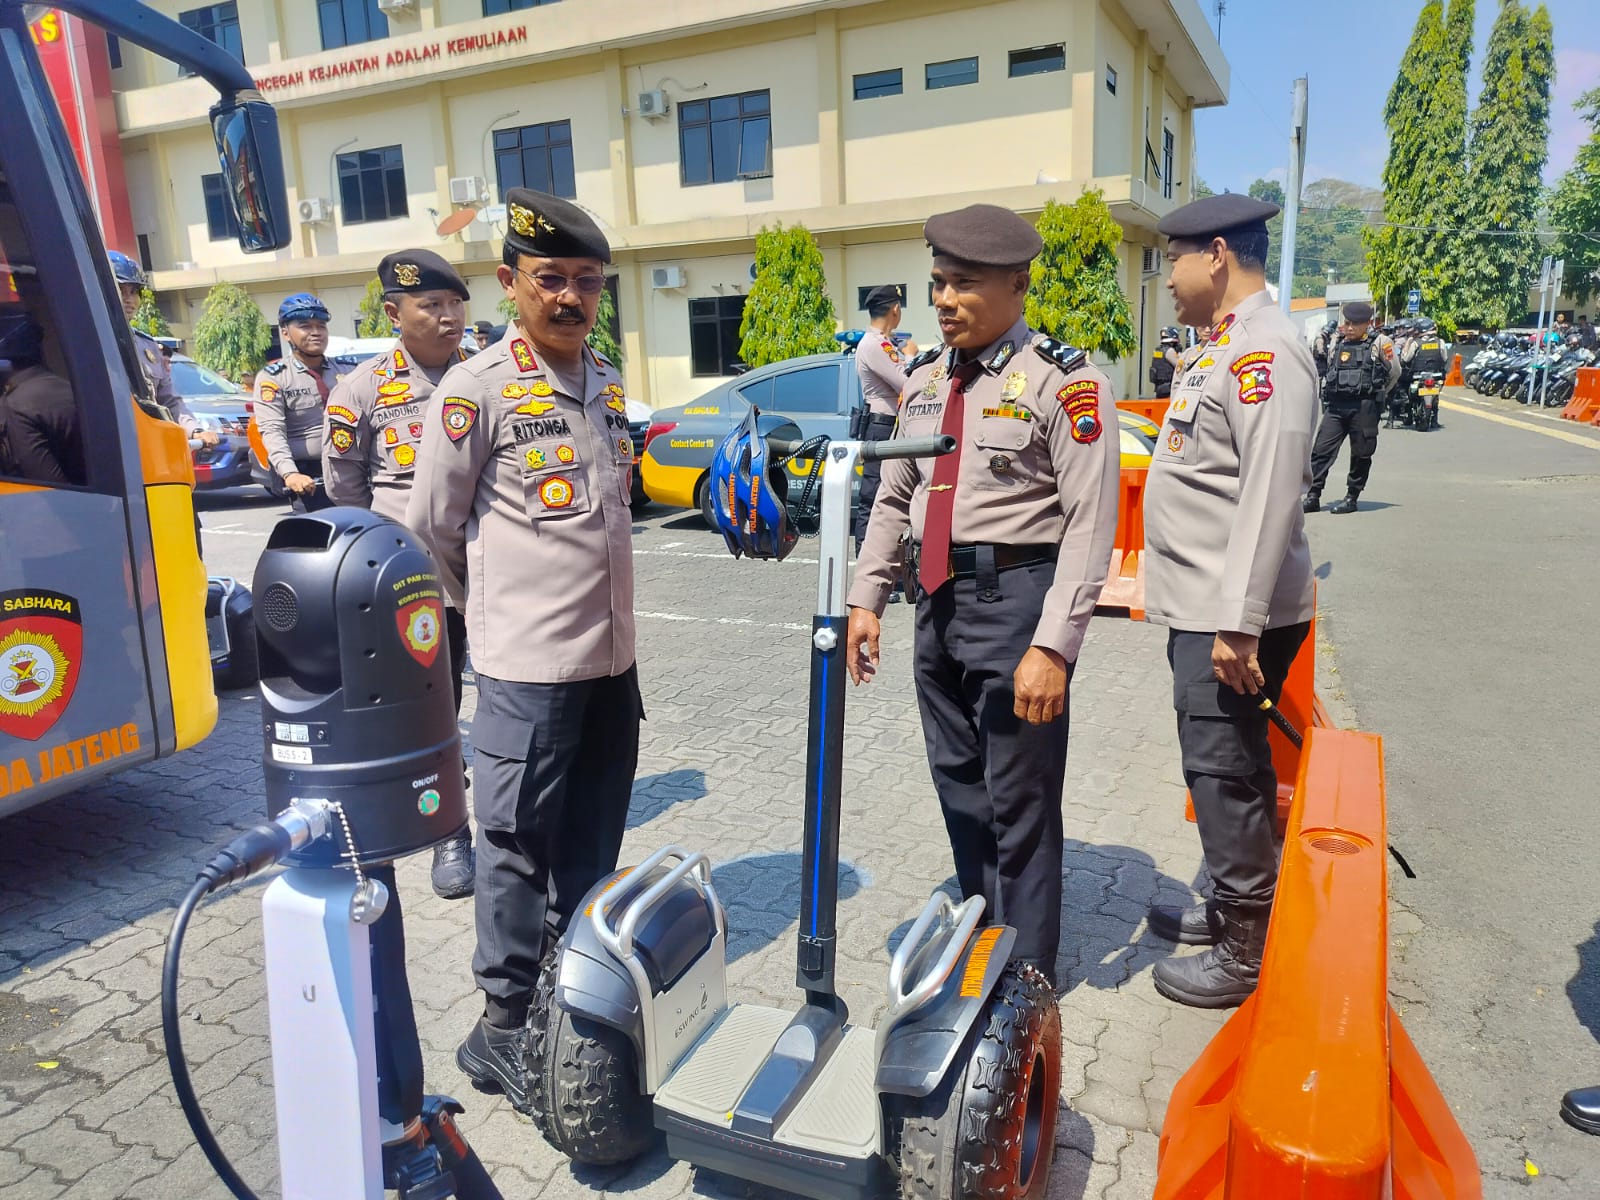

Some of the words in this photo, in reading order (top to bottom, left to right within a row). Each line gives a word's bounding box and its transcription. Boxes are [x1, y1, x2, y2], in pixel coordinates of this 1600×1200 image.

[255, 71, 304, 91] NCEGAH
[309, 56, 380, 81] KEJAHATAN
[386, 44, 440, 66] ADALAH
[447, 26, 528, 55] KEMULIAAN
[1060, 382, 1095, 399] POLDA
[377, 405, 420, 423] DANDUNG
[907, 402, 943, 417] SUTARYO
[511, 418, 572, 441] RITONGA
[670, 439, 689, 448] Contact
[689, 439, 706, 448] Center
[750, 475, 760, 506] JATENG
[749, 509, 757, 534] POLDA
[392, 580, 406, 591] DIT
[3, 597, 72, 613] SABHARA
[38, 722, 140, 784] JATENG
[412, 773, 439, 789] ON/OFF
